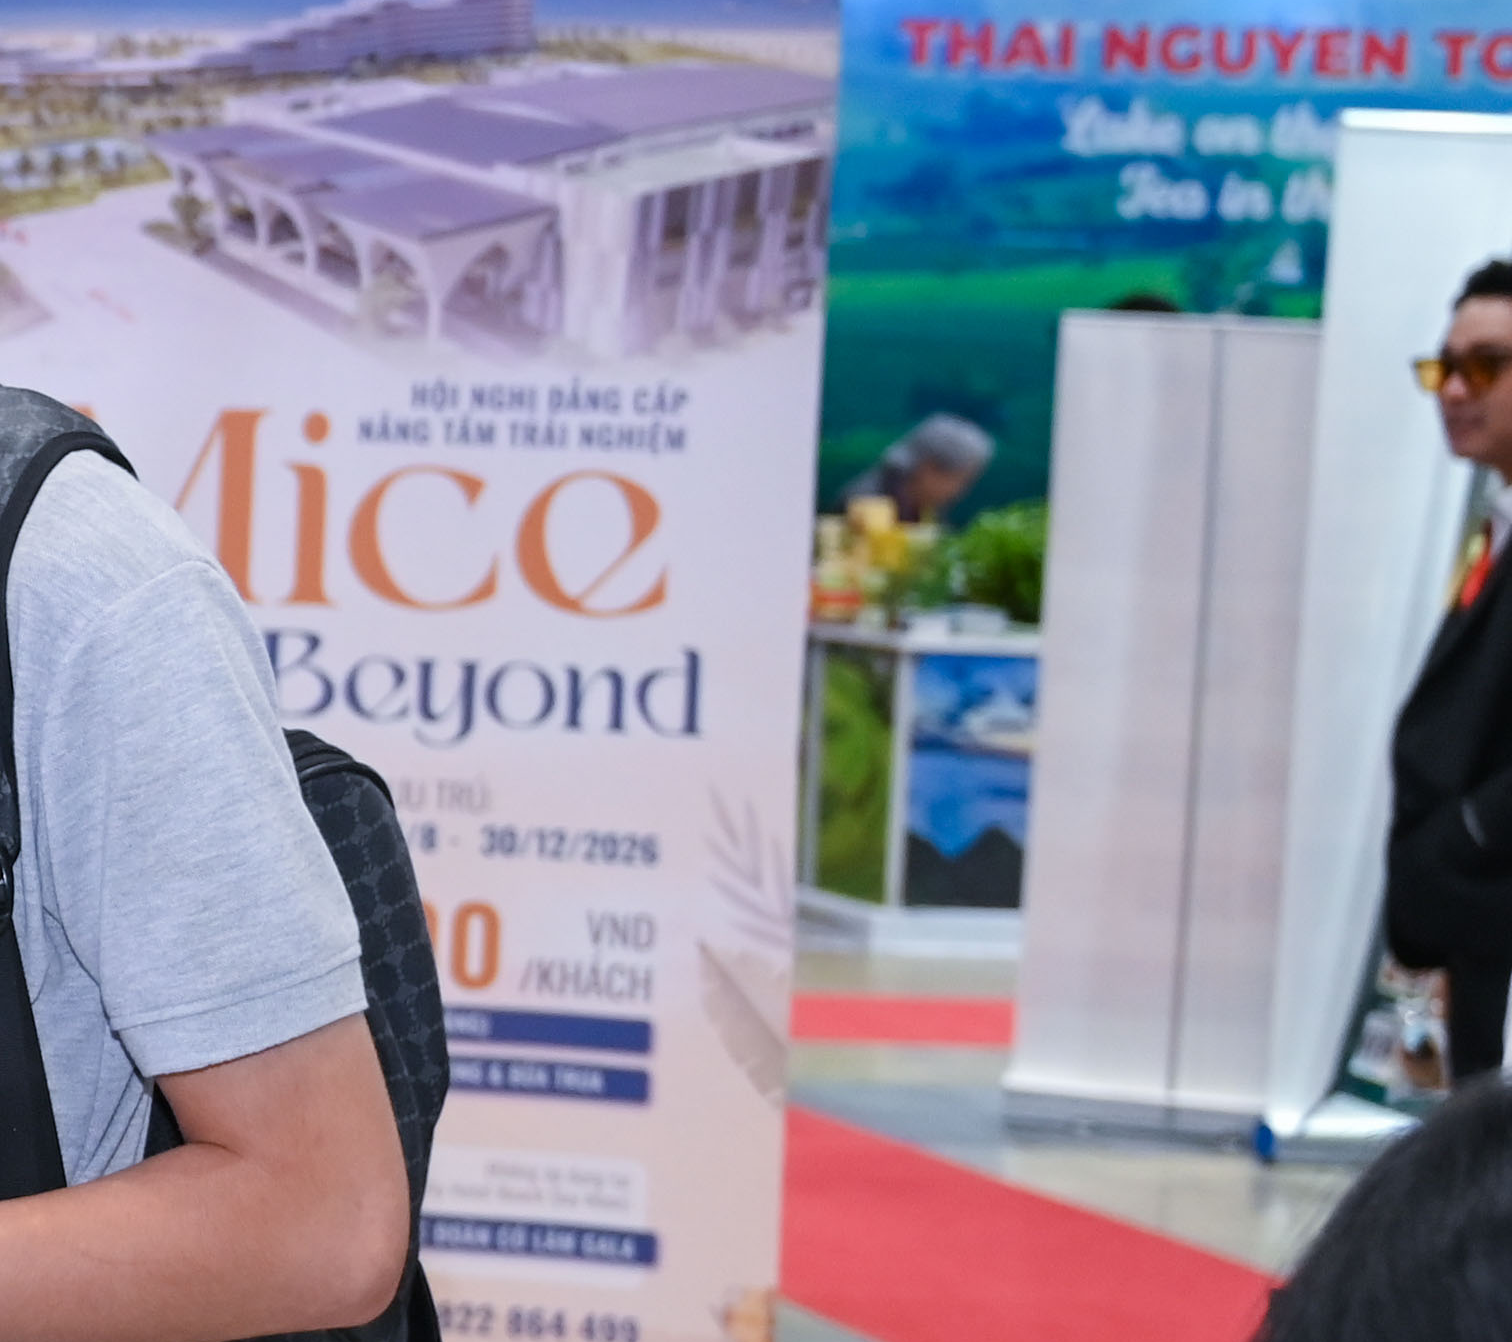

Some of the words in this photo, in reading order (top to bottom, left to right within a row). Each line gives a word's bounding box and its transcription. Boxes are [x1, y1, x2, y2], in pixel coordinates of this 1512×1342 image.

[902, 17, 1079, 75] THAI
[1102, 25, 1407, 80] NGUYEN
[264, 629, 705, 746] Beyond
